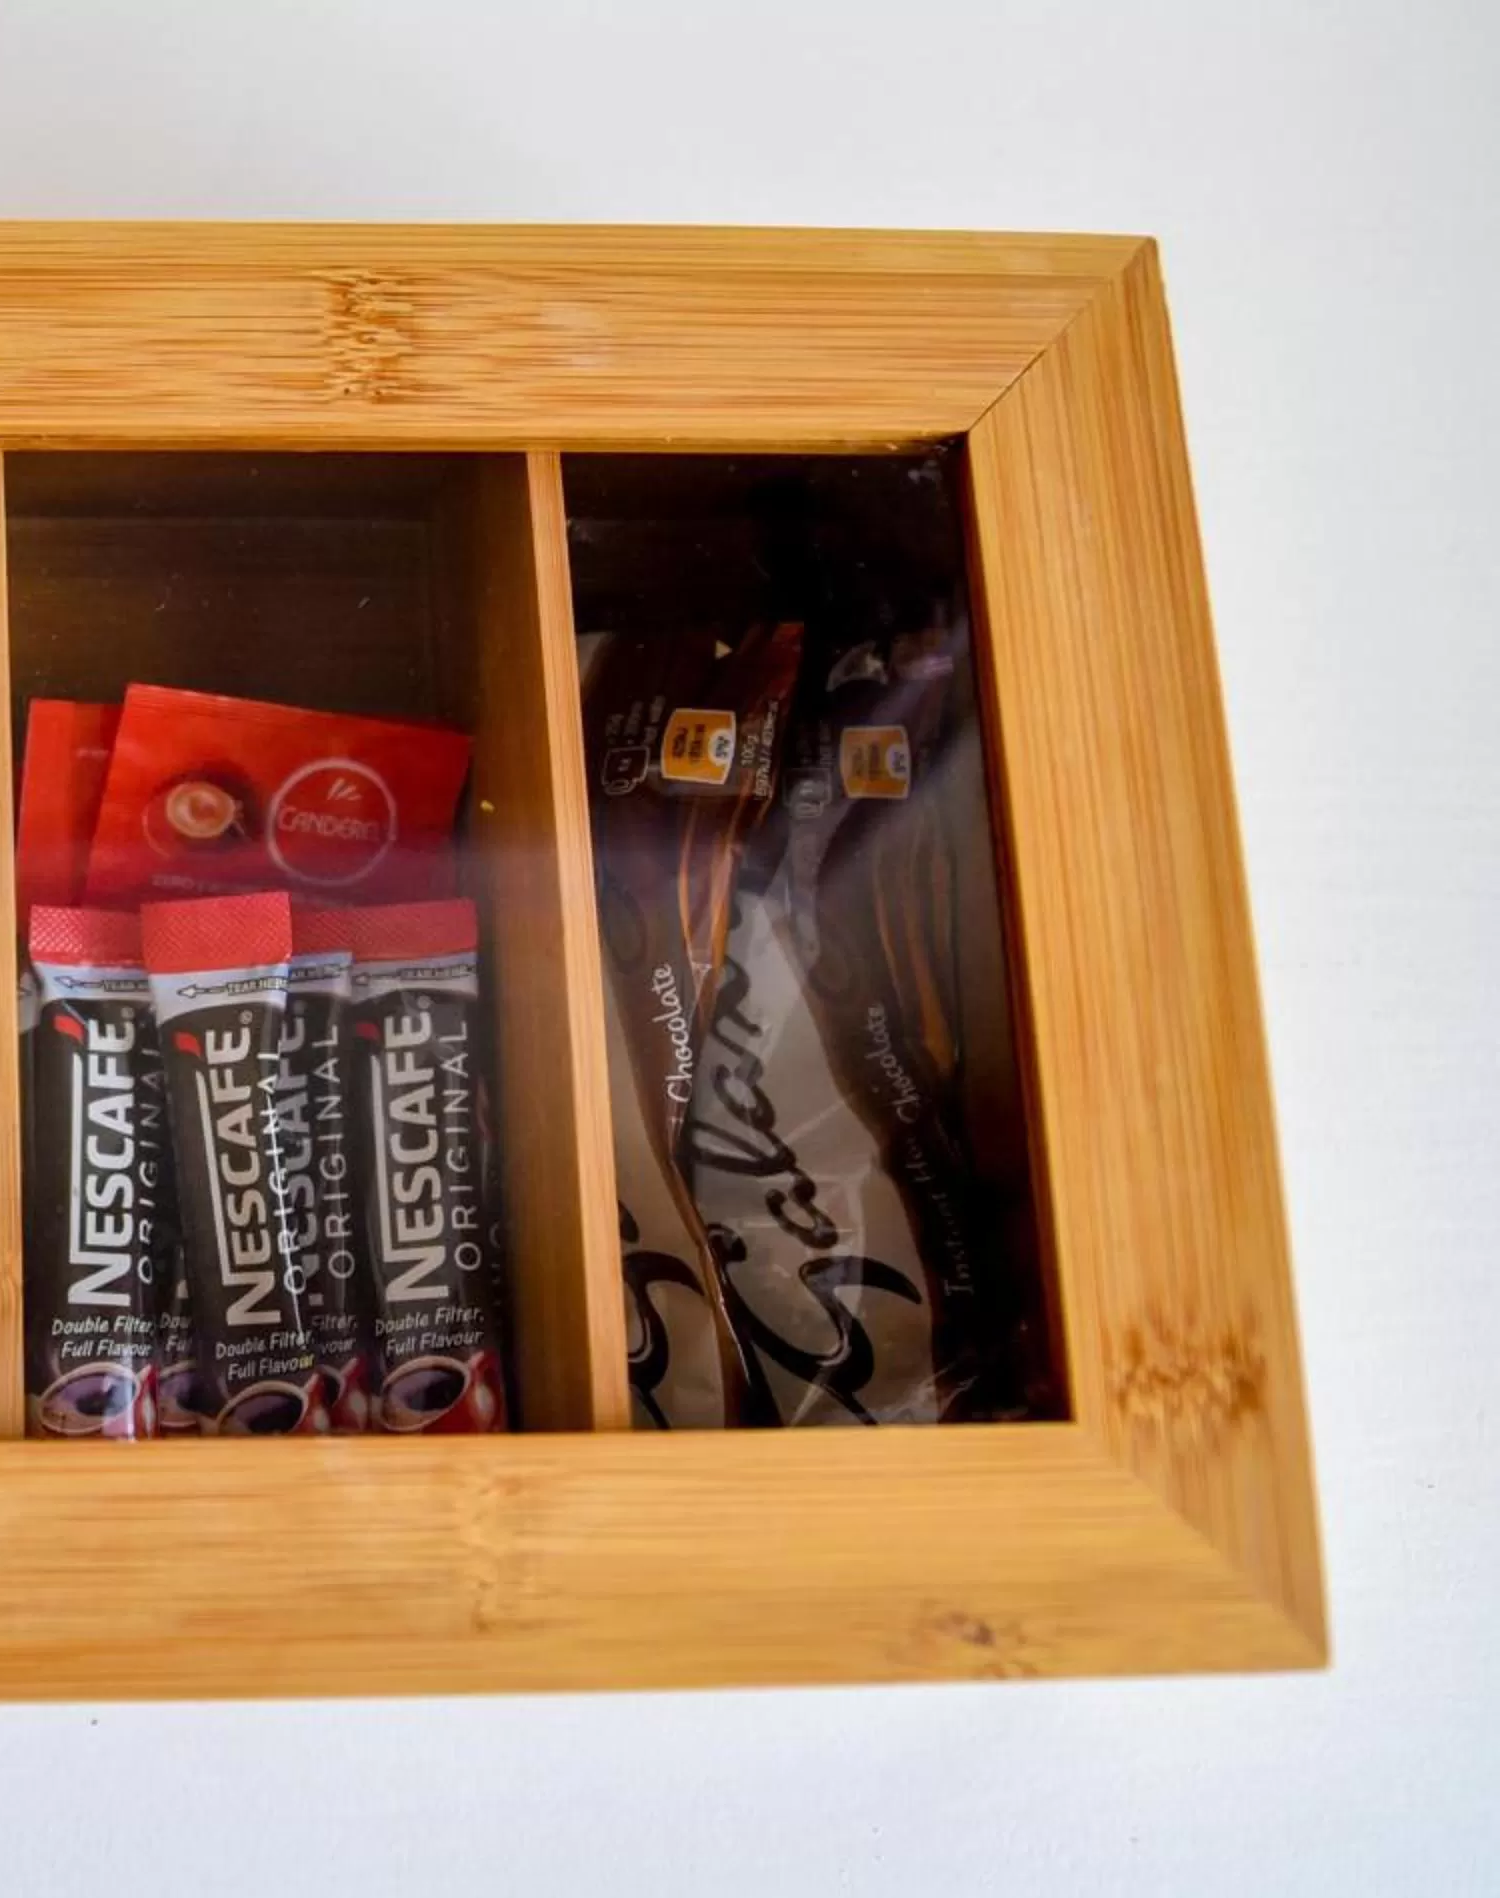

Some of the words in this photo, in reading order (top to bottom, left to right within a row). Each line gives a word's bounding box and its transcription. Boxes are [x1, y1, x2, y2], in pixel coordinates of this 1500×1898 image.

[651, 962, 692, 1104] Chocolate
[864, 1002, 924, 1125] Chocolate
[311, 1022, 356, 1280] ORIGINAL
[439, 1020, 482, 1271] ORIGINAL
[257, 1038, 306, 1295] ORIGINAL
[51, 1316, 109, 1335] Double
[375, 1312, 430, 1337] Double
[61, 1340, 94, 1358] Full
[96, 1339, 152, 1356] Flavour
[215, 1336, 265, 1359] Double
[386, 1337, 416, 1356] Full
[420, 1331, 484, 1350] Flavour
[227, 1361, 255, 1380] Full
[258, 1353, 315, 1375] Flavour
